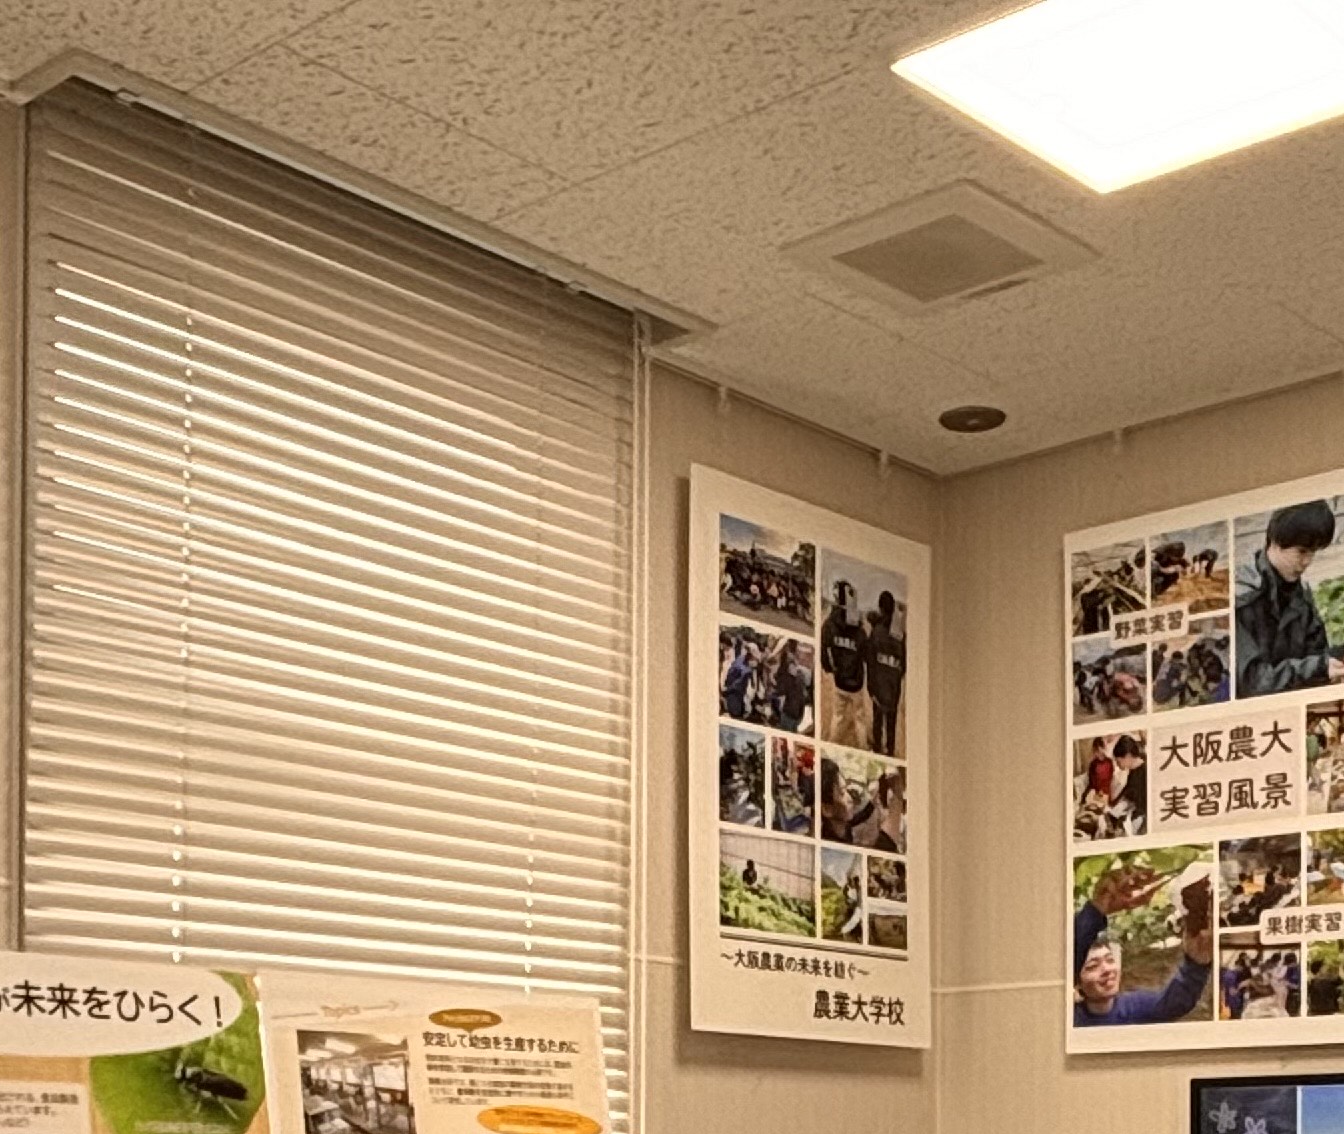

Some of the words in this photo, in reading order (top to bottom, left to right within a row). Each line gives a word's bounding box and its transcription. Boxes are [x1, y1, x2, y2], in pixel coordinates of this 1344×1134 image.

[1113, 611, 1185, 641] 野菜実習
[1158, 720, 1293, 772] 大阪農大
[1159, 771, 1294, 823] 実習風景
[1264, 910, 1343, 938] 果樹実習
[813, 988, 906, 1026] 農業大学校
